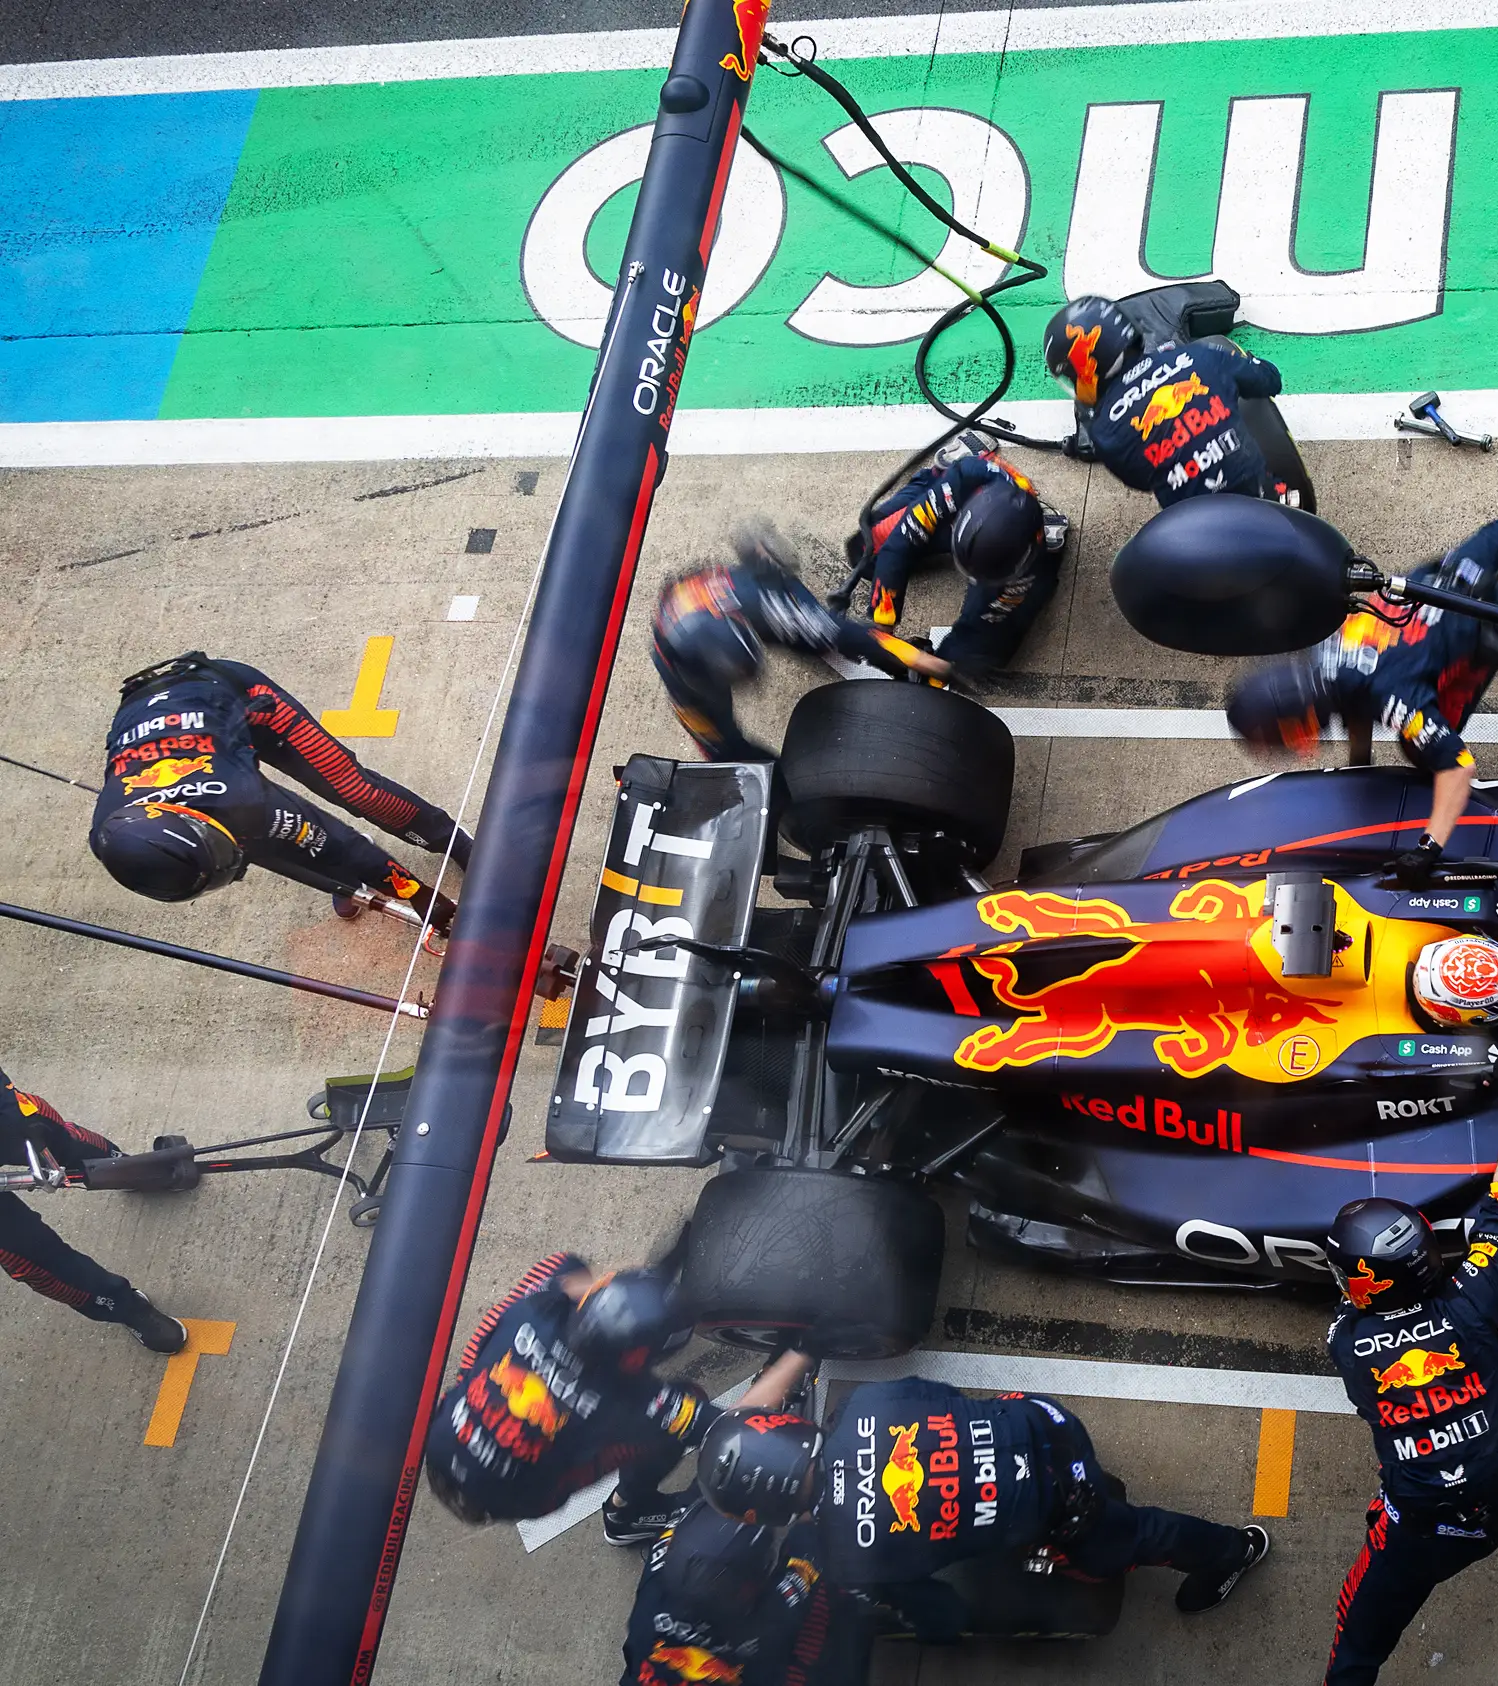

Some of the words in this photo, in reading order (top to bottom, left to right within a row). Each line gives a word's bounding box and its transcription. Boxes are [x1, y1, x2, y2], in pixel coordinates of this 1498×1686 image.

[633, 268, 686, 415] ORACLE
[1109, 352, 1193, 421] ORACLE
[137, 711, 204, 739] Mobil
[124, 781, 227, 808] ORACL
[1409, 898, 1431, 908] App
[1433, 899, 1459, 908] Cash
[574, 803, 714, 1112] BYBIT
[1420, 1044, 1447, 1054] Cash
[1449, 1045, 1472, 1057] App
[1060, 1090, 1146, 1131] Red
[1154, 1098, 1242, 1153] Bull
[1376, 1096, 1456, 1120] ROKT
[1354, 1318, 1454, 1357] ORACLE
[1377, 1390, 1430, 1428] Red
[1428, 1371, 1487, 1414] Bull
[928, 1412, 959, 1470] Bull
[1393, 1422, 1464, 1461] Mobil
[856, 1416, 876, 1549] ORACLE
[929, 1477, 960, 1541] Red
[974, 1447, 998, 1527] Mobil
[373, 1466, 415, 1612] @REDBULLRACING
